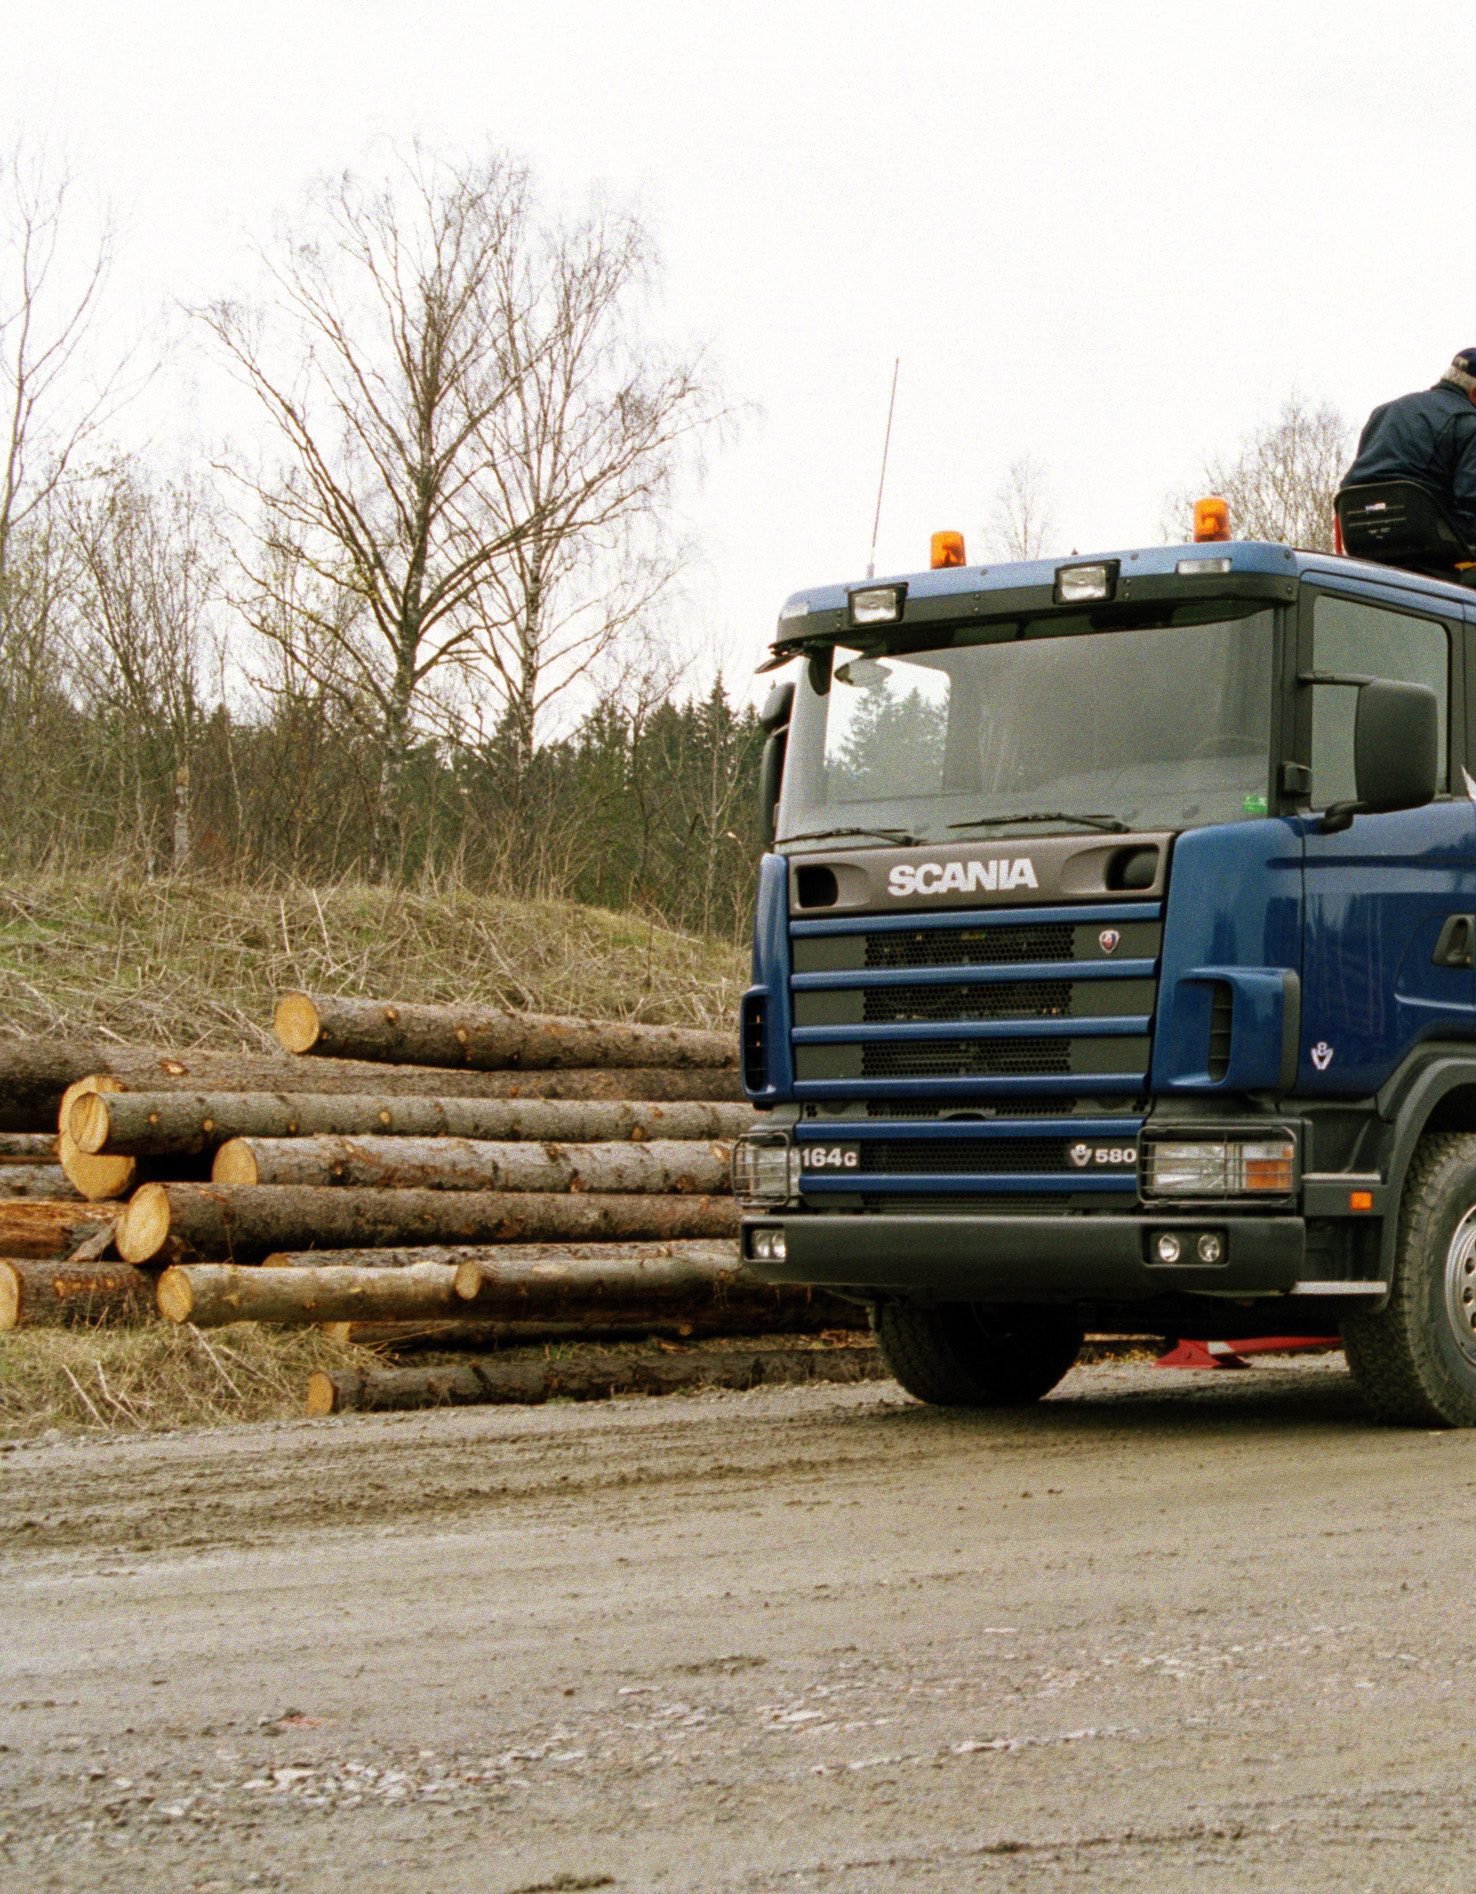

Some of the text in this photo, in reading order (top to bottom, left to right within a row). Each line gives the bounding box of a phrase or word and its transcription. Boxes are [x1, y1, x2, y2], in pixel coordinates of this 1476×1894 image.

[888, 858, 1039, 897] SCANIA
[802, 1147, 857, 1167] 164G
[1095, 1148, 1137, 1163] 580
